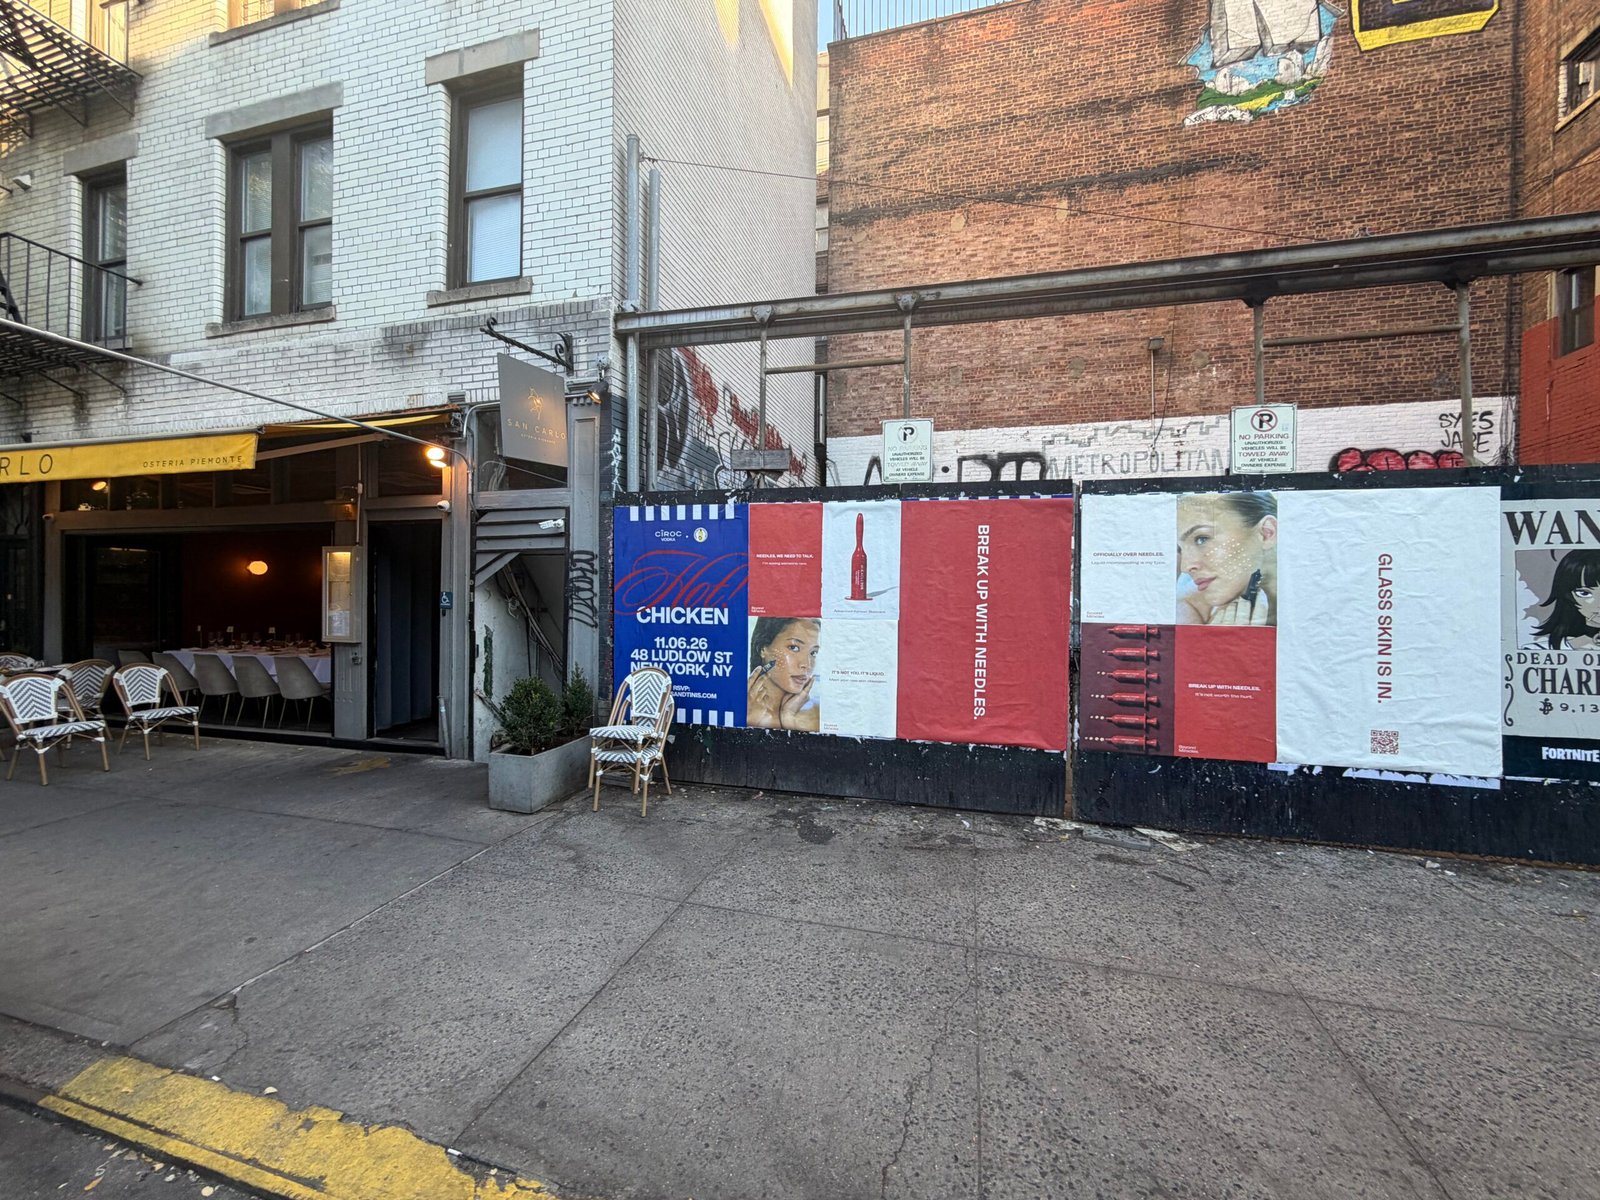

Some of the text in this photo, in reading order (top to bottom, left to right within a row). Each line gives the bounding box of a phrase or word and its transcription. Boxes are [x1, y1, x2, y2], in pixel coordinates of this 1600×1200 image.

[507, 418, 566, 440] SAN CARLO
[143, 455, 242, 468] OSTERIA PIEMONTE
[1049, 448, 1223, 479] METROPOLITAN
[1502, 509, 1600, 545] WAN
[636, 606, 729, 625] CHICKEN
[973, 525, 990, 720] BREAK UP WITH NEEDLES.
[1377, 553, 1393, 703] GLASS SKIN IS IN.
[654, 636, 708, 649] 11.06.26
[630, 648, 734, 664] 48 LUDLOW ST
[1516, 652, 1568, 665] DEAD
[666, 663, 709, 679] YORK,
[712, 664, 733, 677] NY
[671, 691, 717, 699] SANDTINIS.COM
[1541, 747, 1600, 763] FORTNITE
